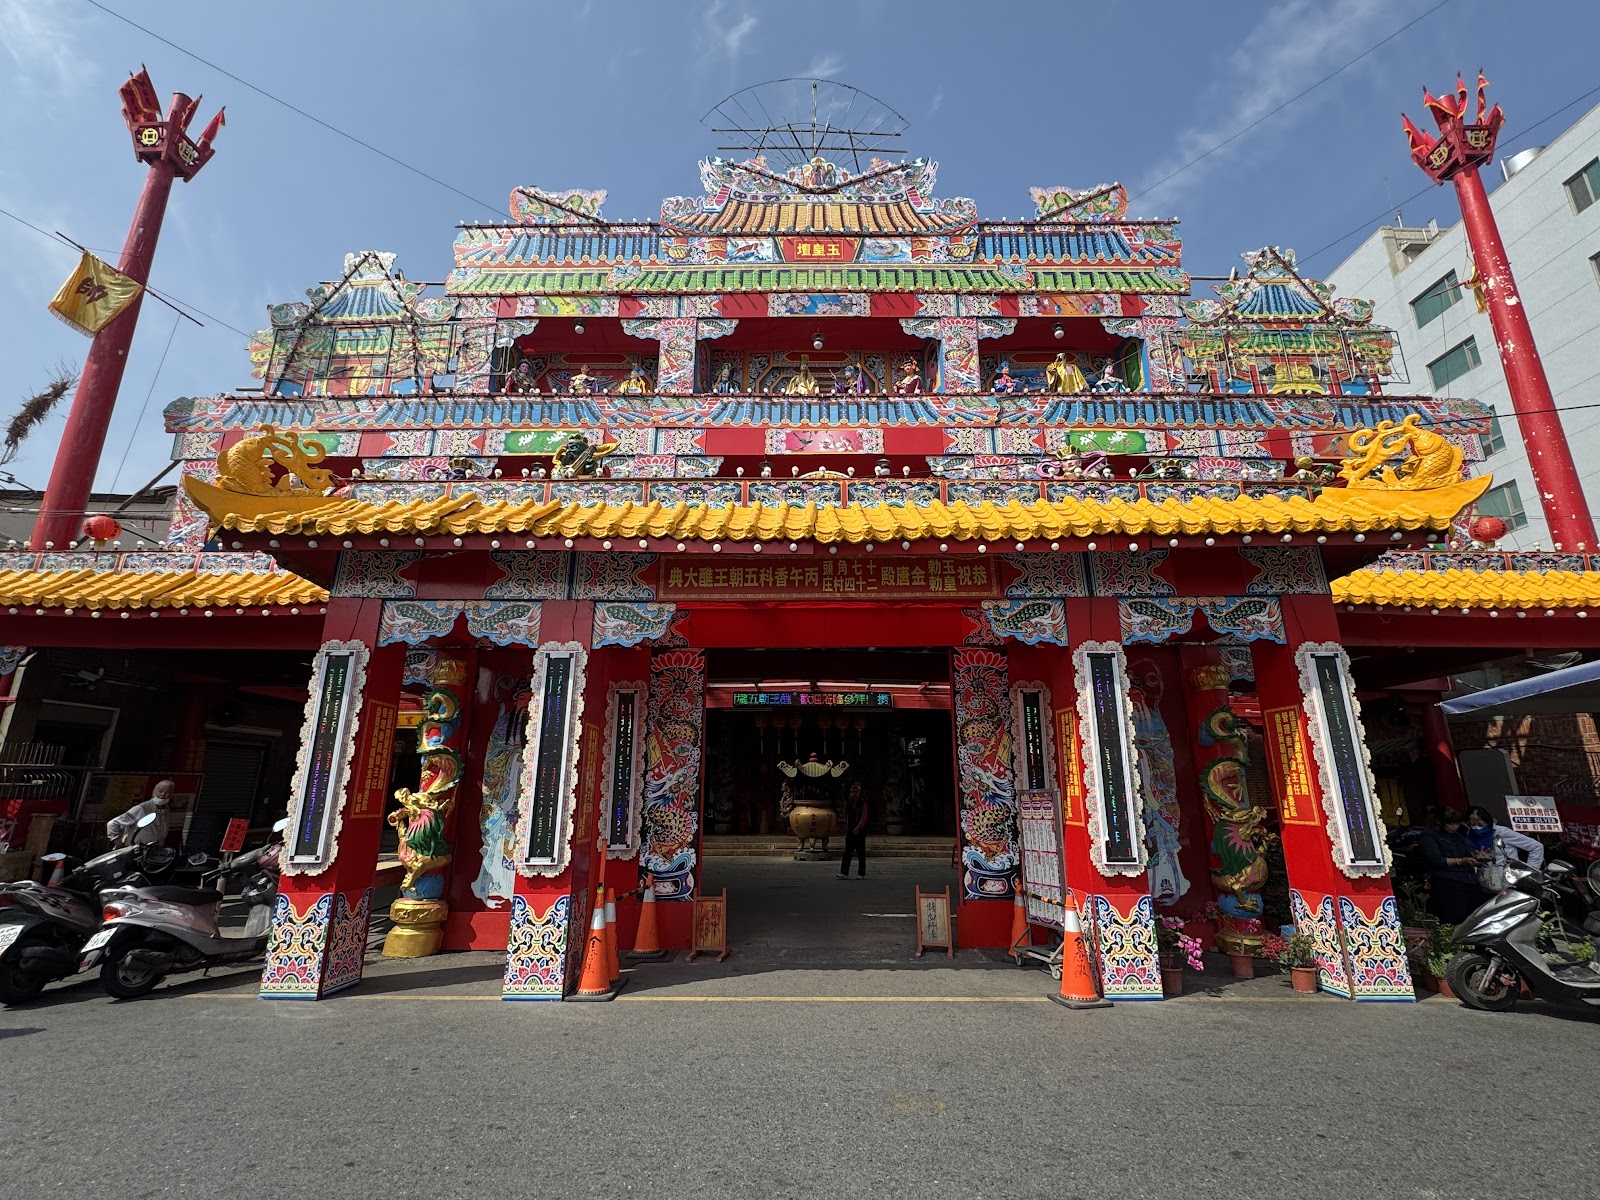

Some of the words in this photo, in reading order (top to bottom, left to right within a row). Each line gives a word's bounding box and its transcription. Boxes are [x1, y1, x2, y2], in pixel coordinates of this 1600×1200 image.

[797, 243, 840, 256] 玉皇壇
[668, 566, 819, 588] 丙午香科五朝王醮大典
[822, 559, 877, 575] 十七角頭
[881, 566, 926, 587] 金唐殿
[957, 565, 988, 586] 恭祝
